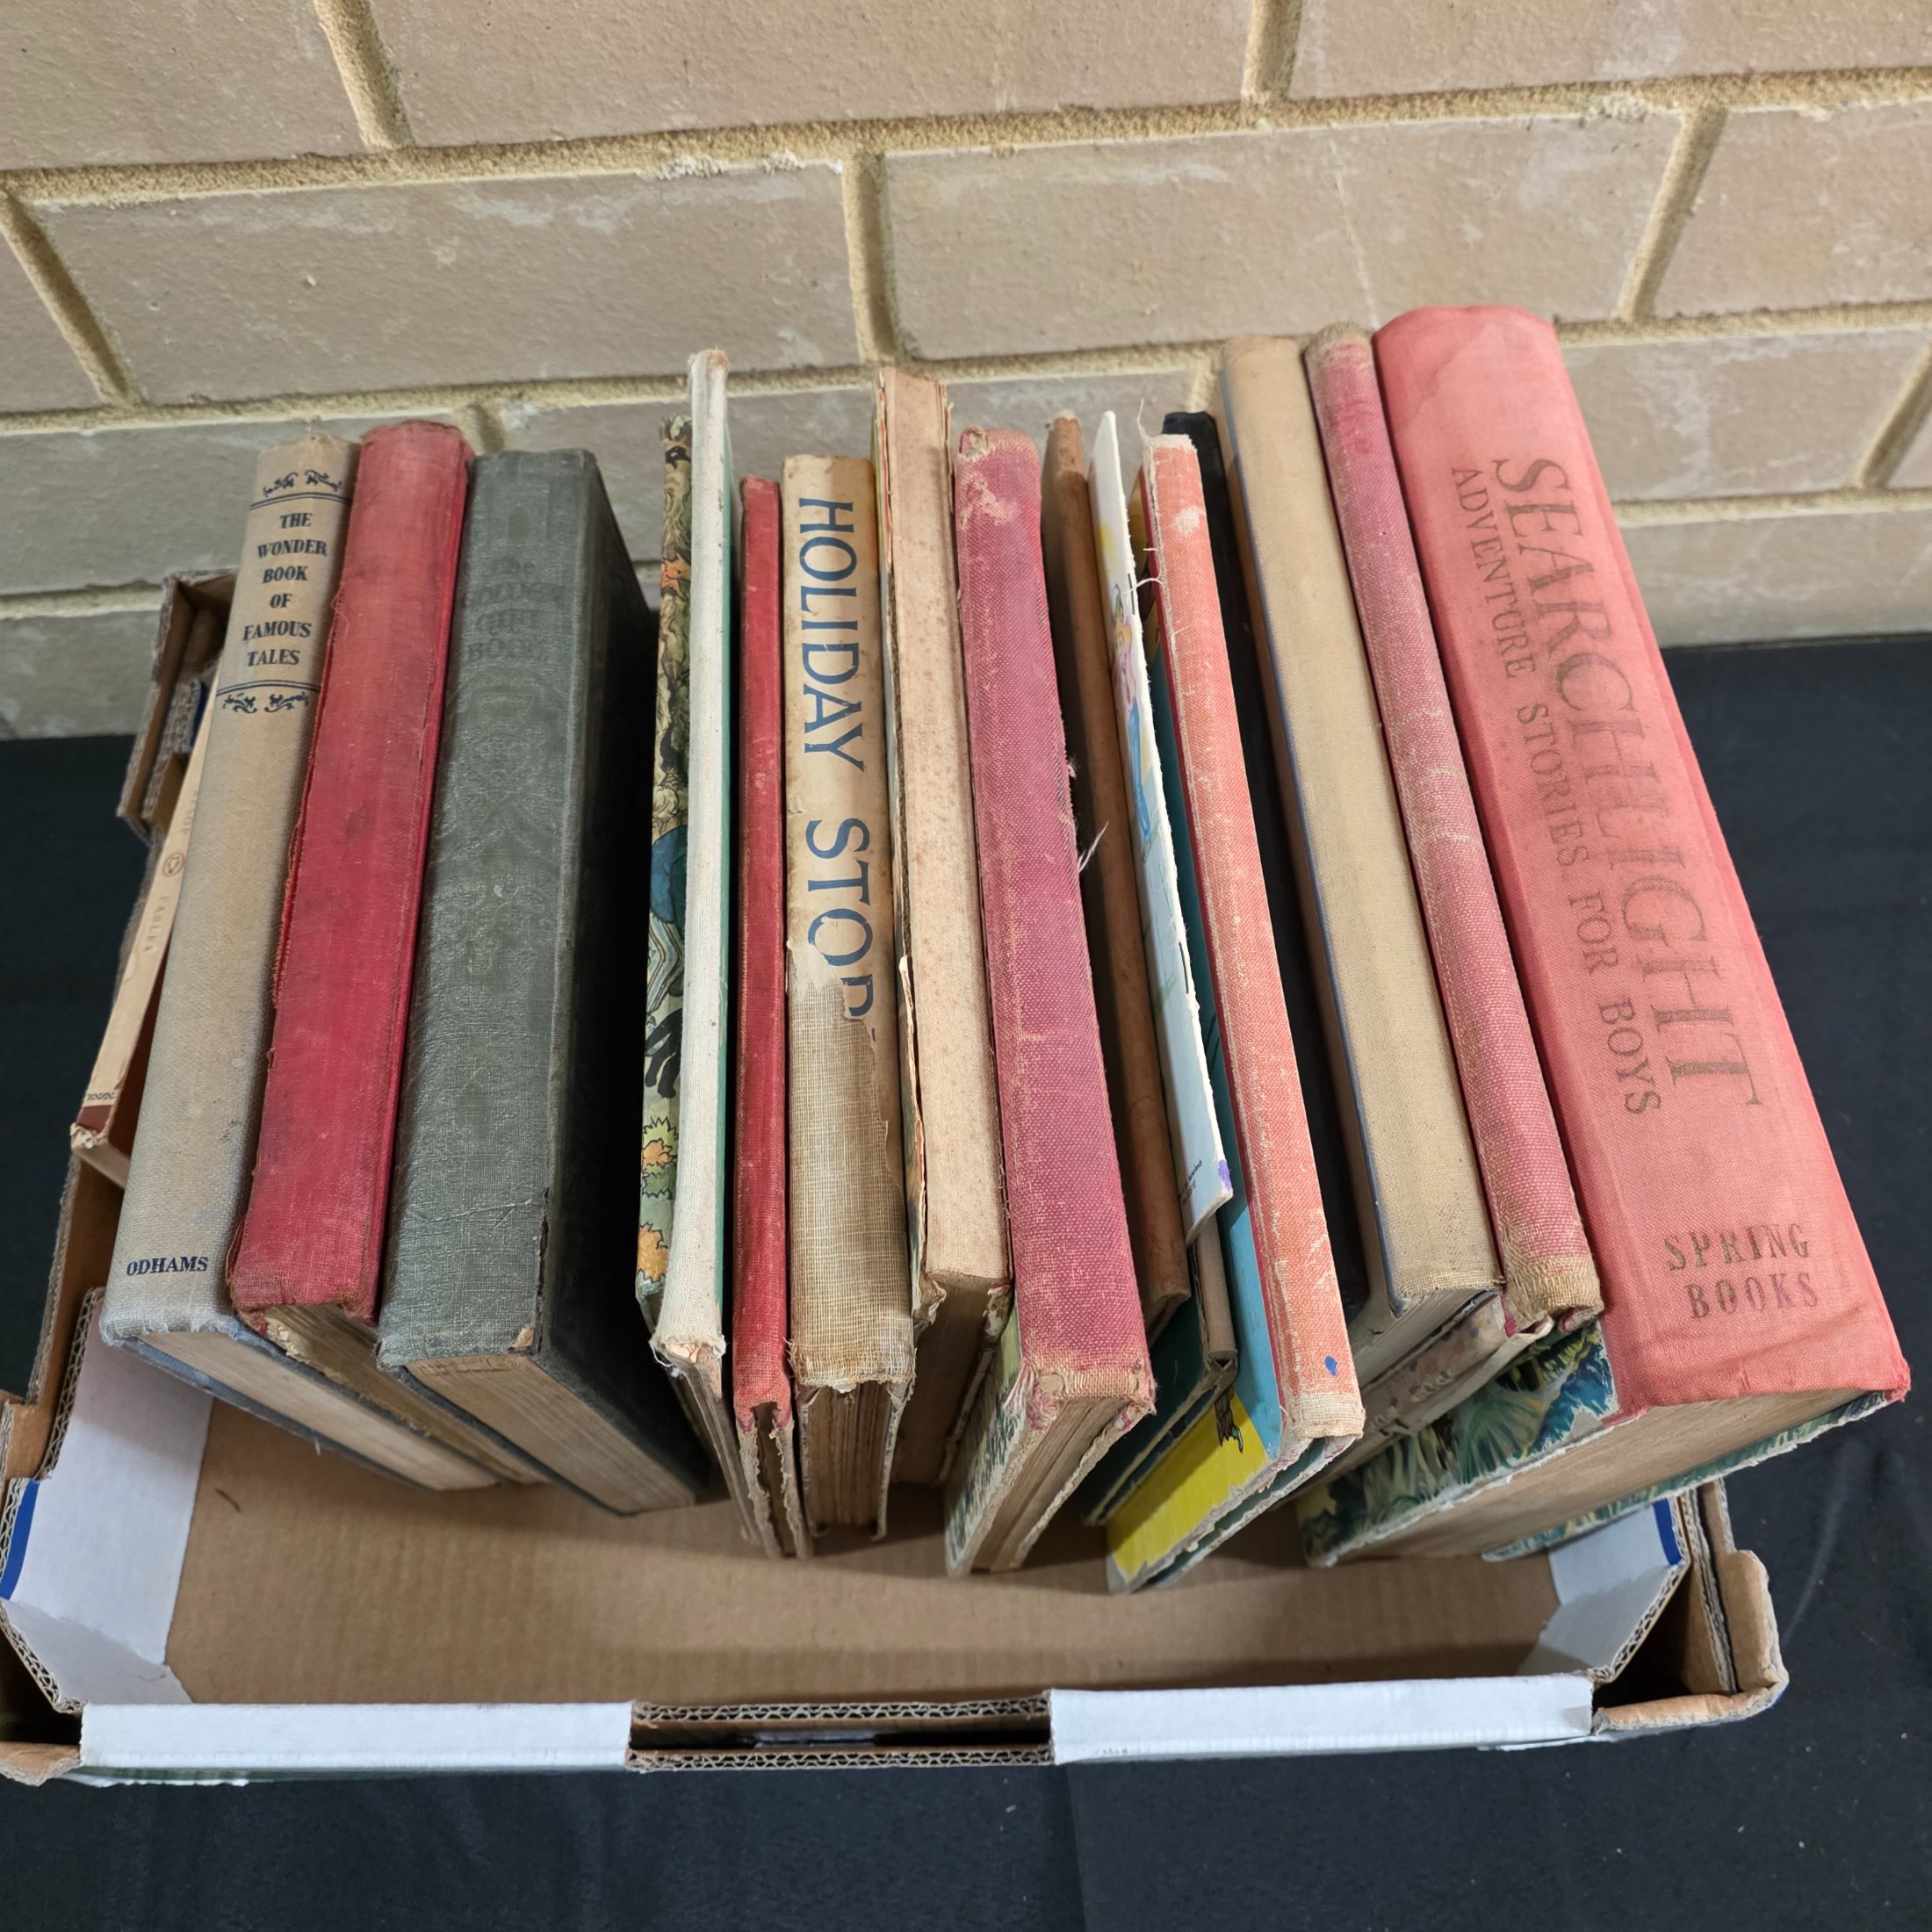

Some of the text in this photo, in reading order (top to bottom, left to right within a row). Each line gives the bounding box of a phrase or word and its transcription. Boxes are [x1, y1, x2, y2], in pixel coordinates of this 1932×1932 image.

[279, 512, 313, 529] THE
[257, 539, 328, 559] WONDER
[262, 566, 309, 584] BOOK
[270, 593, 293, 609] OF
[242, 620, 313, 641] FAMOUS
[247, 649, 300, 667] TALES
[797, 496, 876, 1042] HOLIDAY STO
[1452, 466, 1662, 1114] ADVENTURE STORIES FOR BOYS
[1492, 458, 1761, 1107] SEARCHLIGHT
[1664, 1222, 1812, 1271] SPRING
[126, 1256, 209, 1276] ODHAMS
[1686, 1272, 1820, 1319] BOOKS
